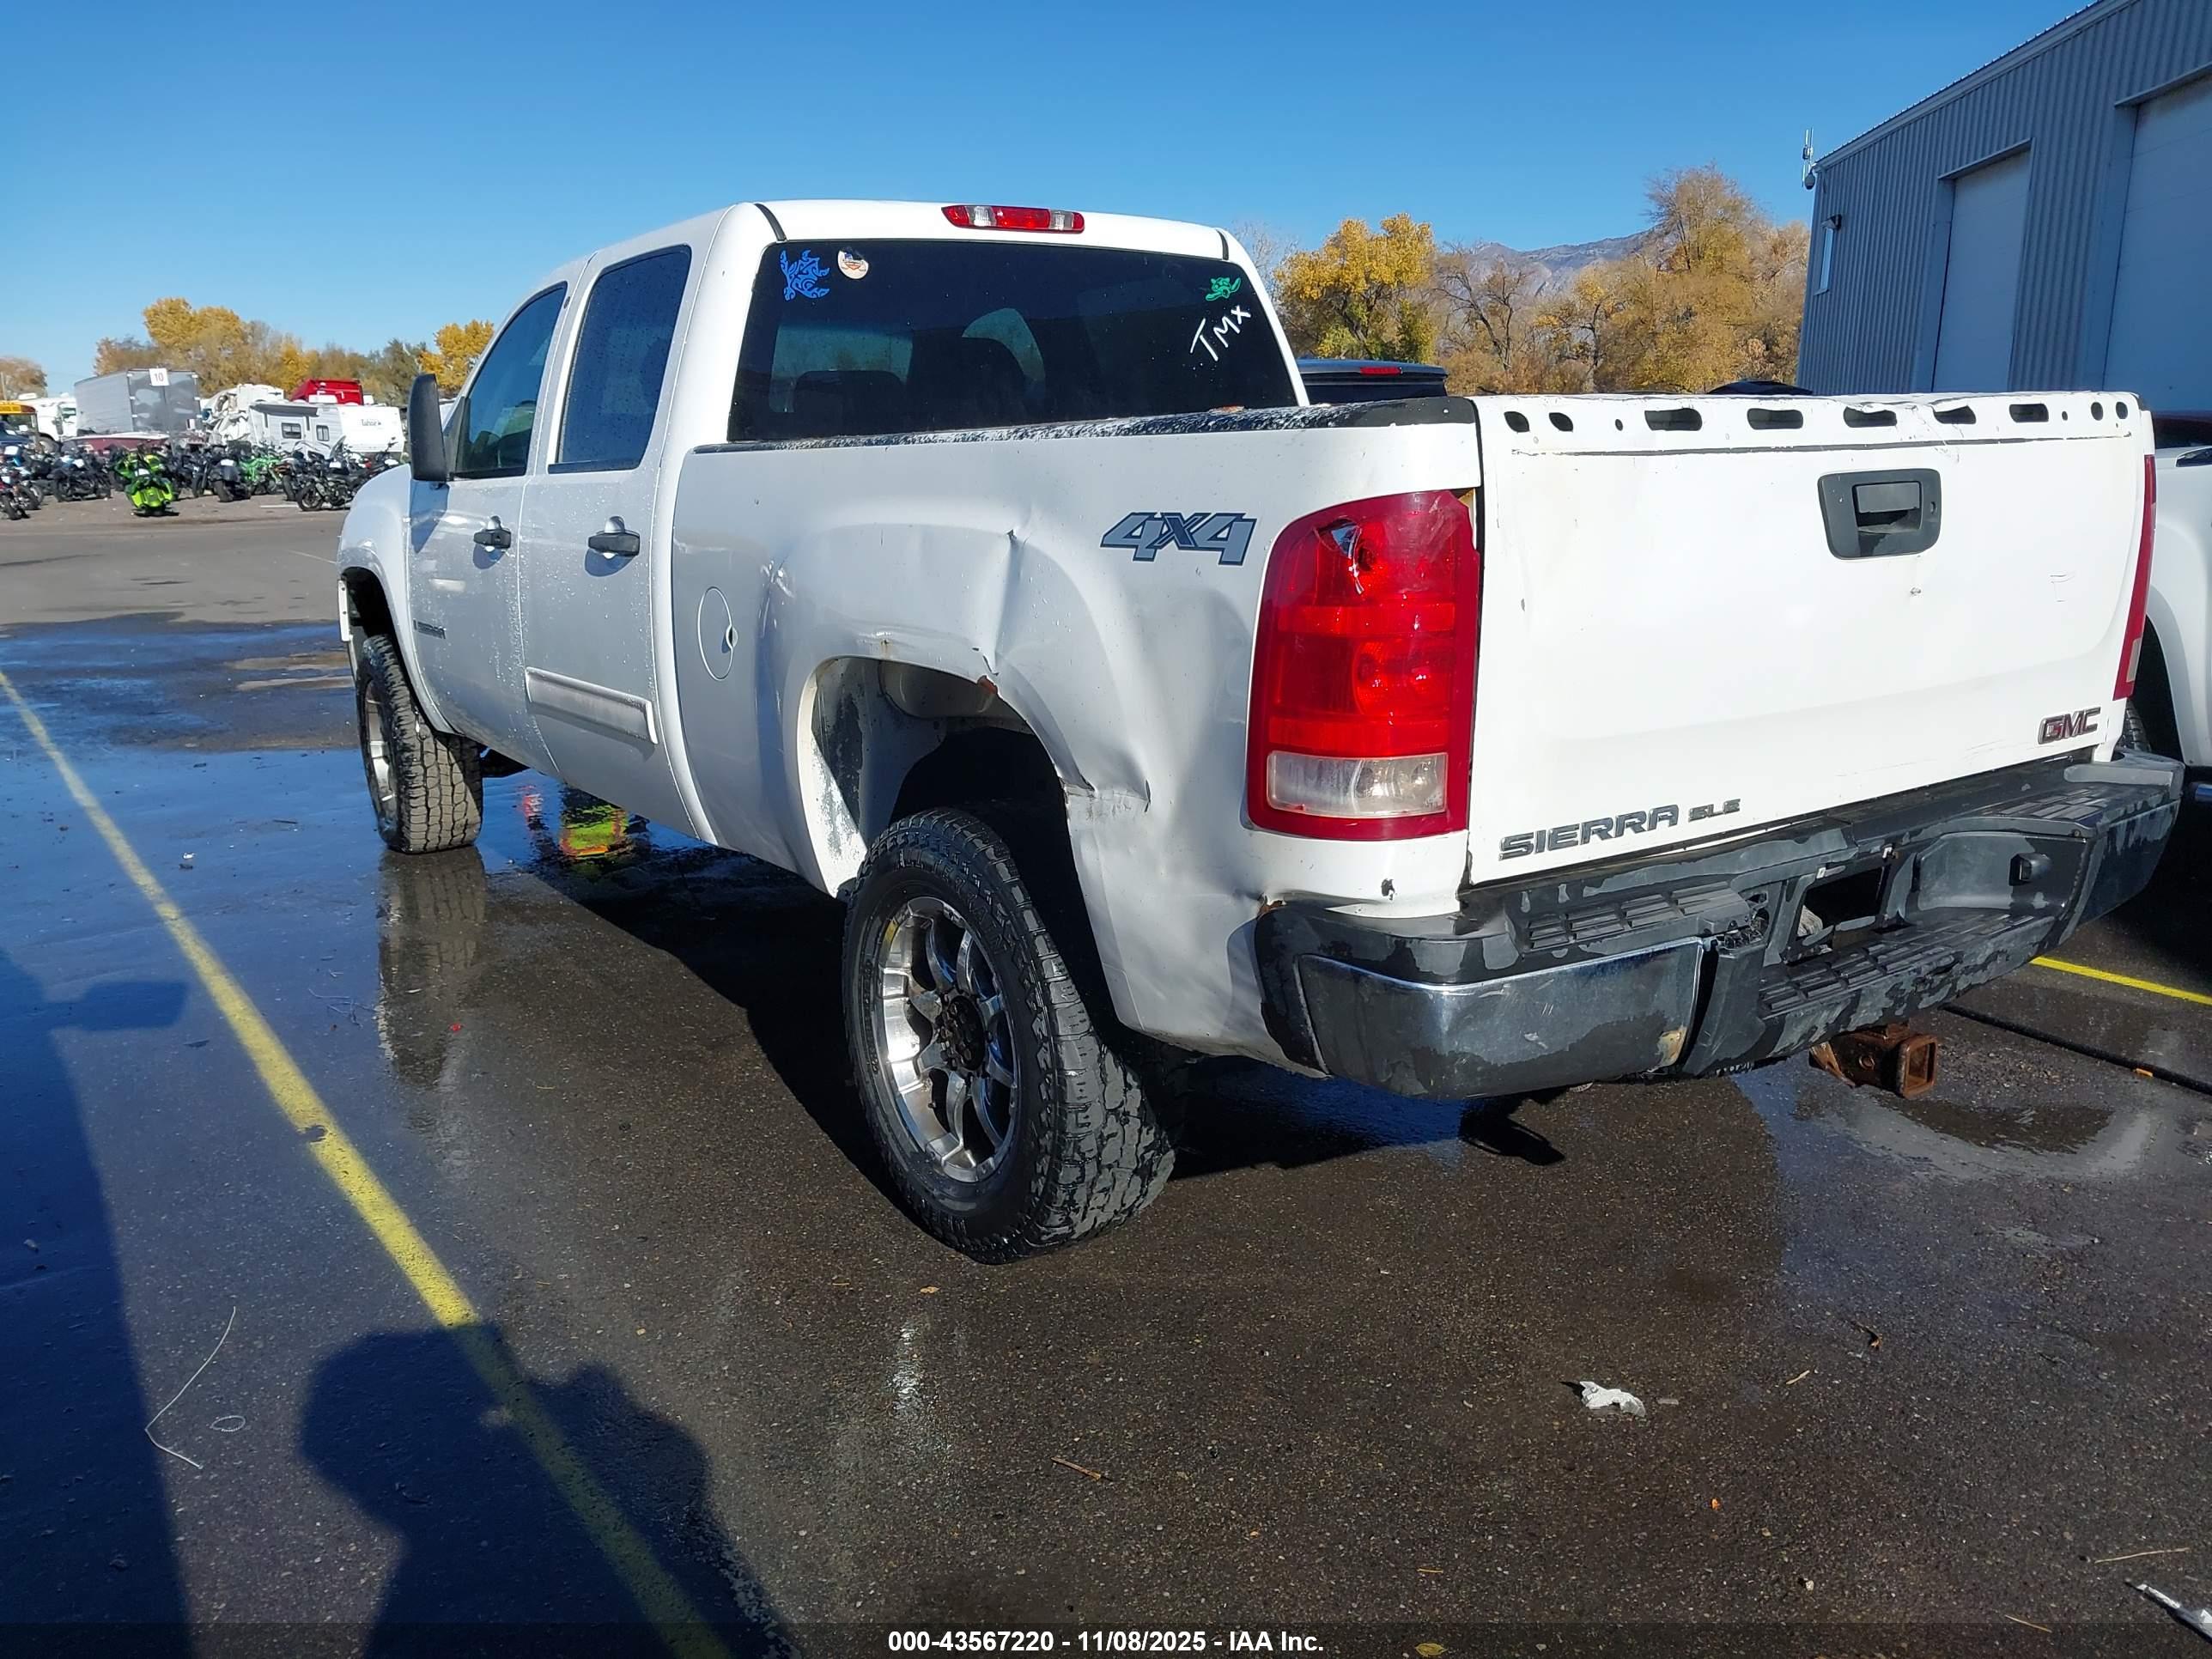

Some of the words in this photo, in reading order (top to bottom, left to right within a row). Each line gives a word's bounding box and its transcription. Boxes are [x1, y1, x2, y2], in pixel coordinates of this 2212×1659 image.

[155, 372, 164, 382] 10
[2038, 706, 2101, 745] GMC
[1498, 804, 1680, 861] SIERRA
[1688, 798, 1741, 823] SLE
